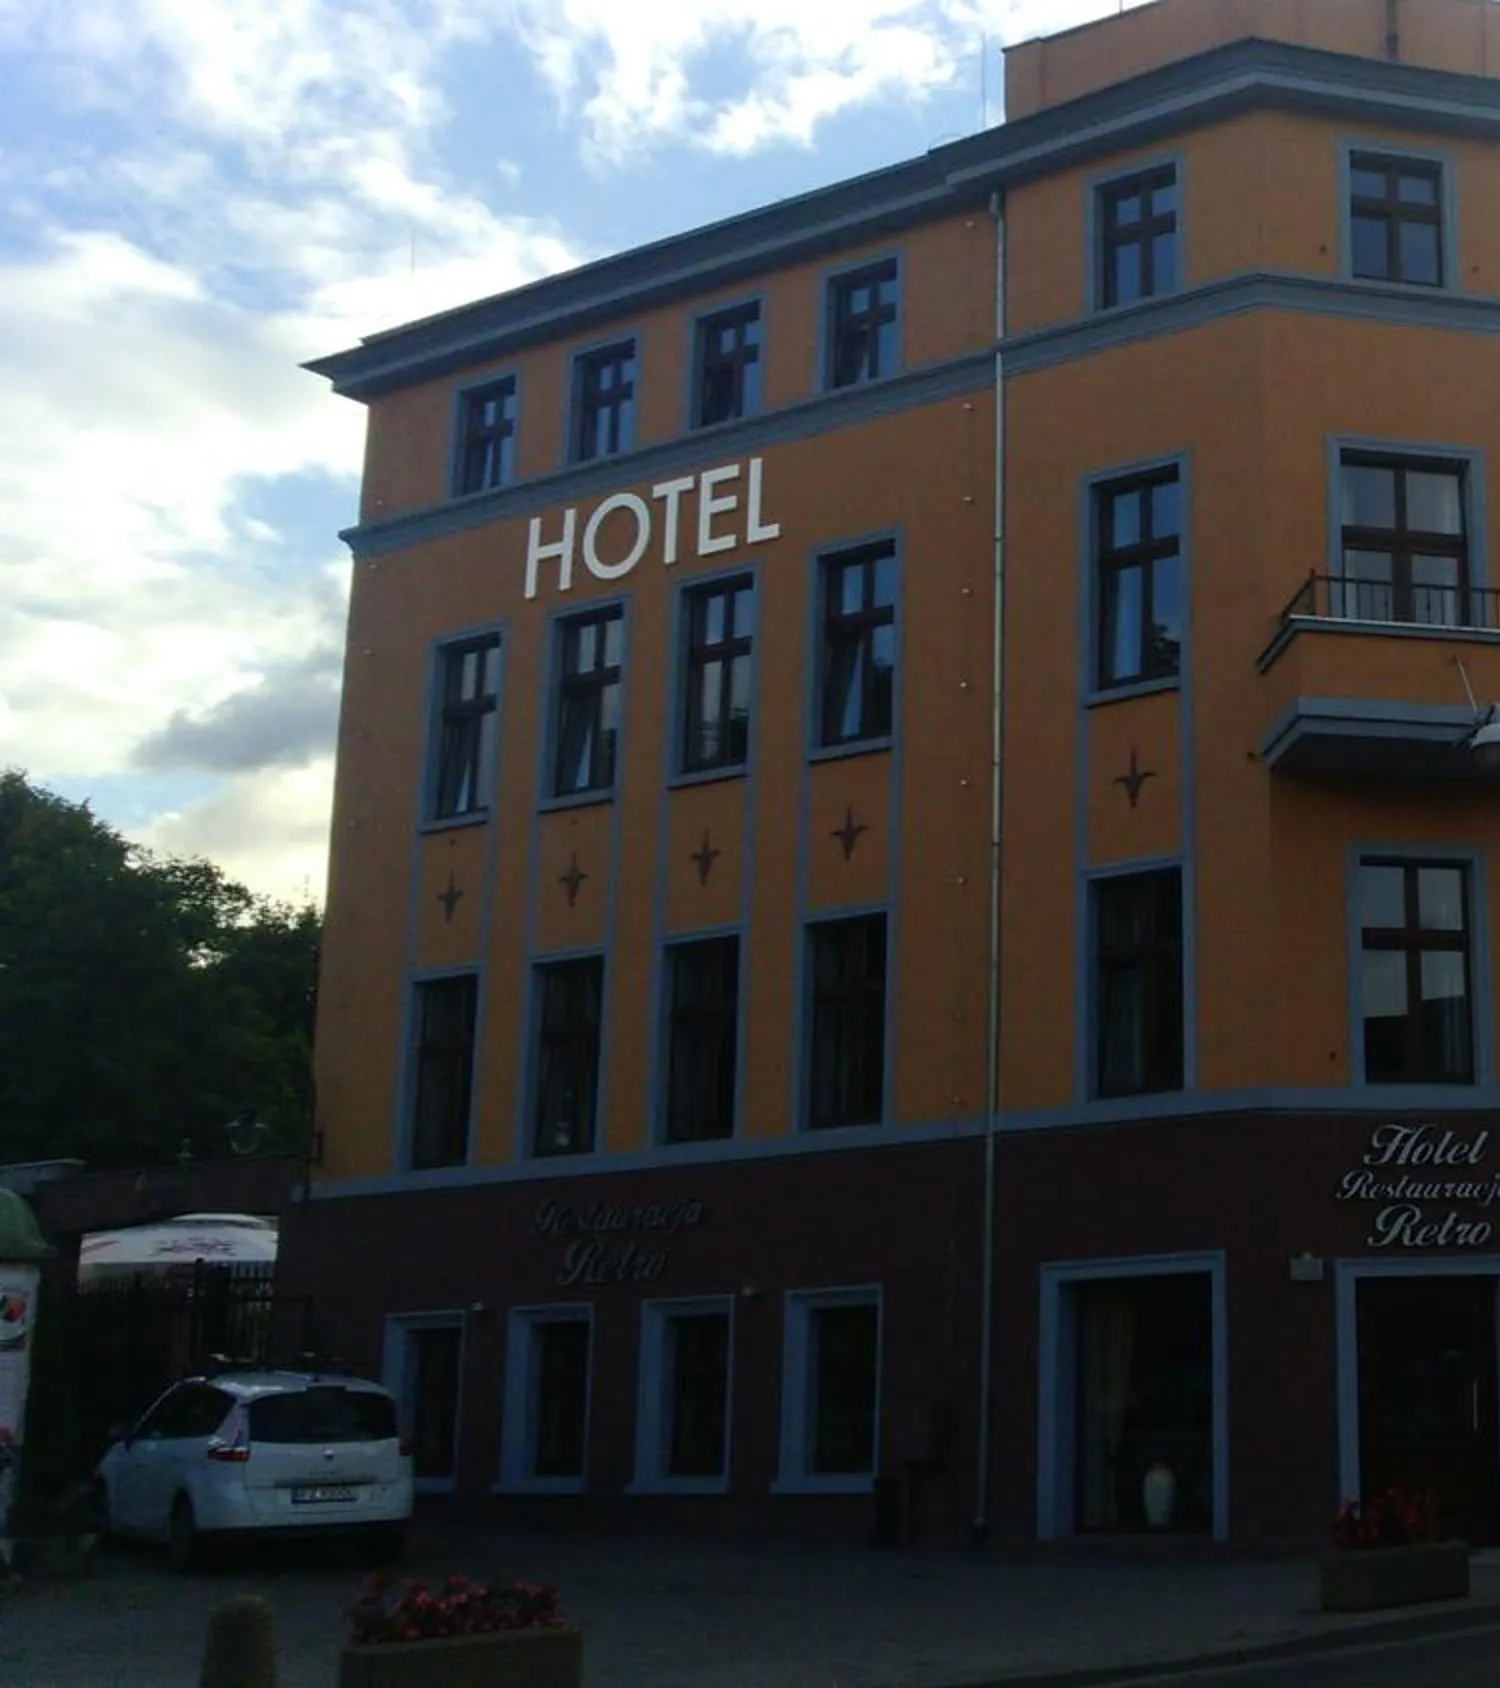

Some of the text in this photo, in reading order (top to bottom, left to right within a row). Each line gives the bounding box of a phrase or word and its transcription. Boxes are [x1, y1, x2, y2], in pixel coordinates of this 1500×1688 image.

[524, 457, 780, 599] HOTEL
[1363, 1123, 1489, 1165] Hotel
[530, 1200, 704, 1234] Restauracja
[1367, 1204, 1492, 1247] Retro
[556, 1235, 671, 1285] Retro
